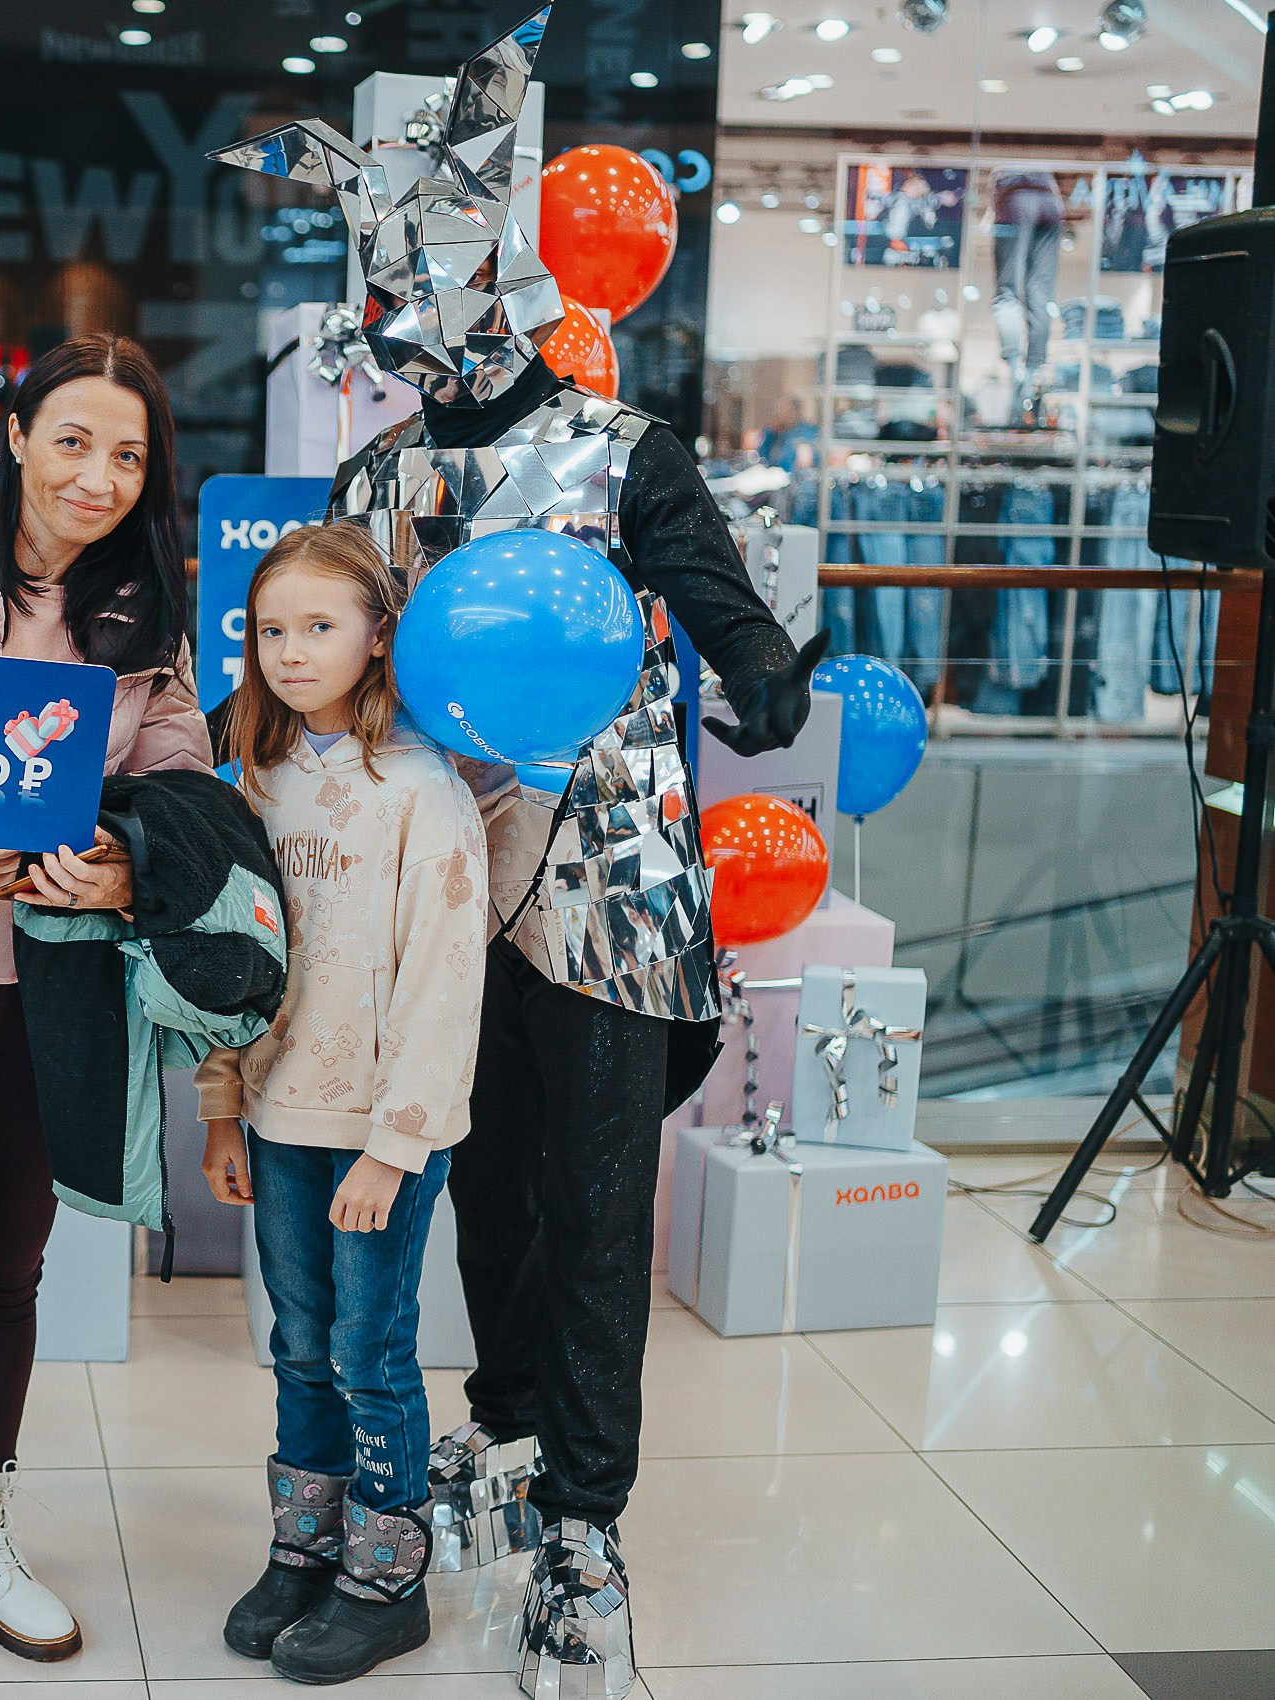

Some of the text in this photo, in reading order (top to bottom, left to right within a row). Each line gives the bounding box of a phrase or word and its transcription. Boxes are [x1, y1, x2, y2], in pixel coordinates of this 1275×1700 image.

[276, 836, 339, 882] MISHKA
[318, 1080, 355, 1104] MISHKA
[363, 1446, 371, 1458] IN
